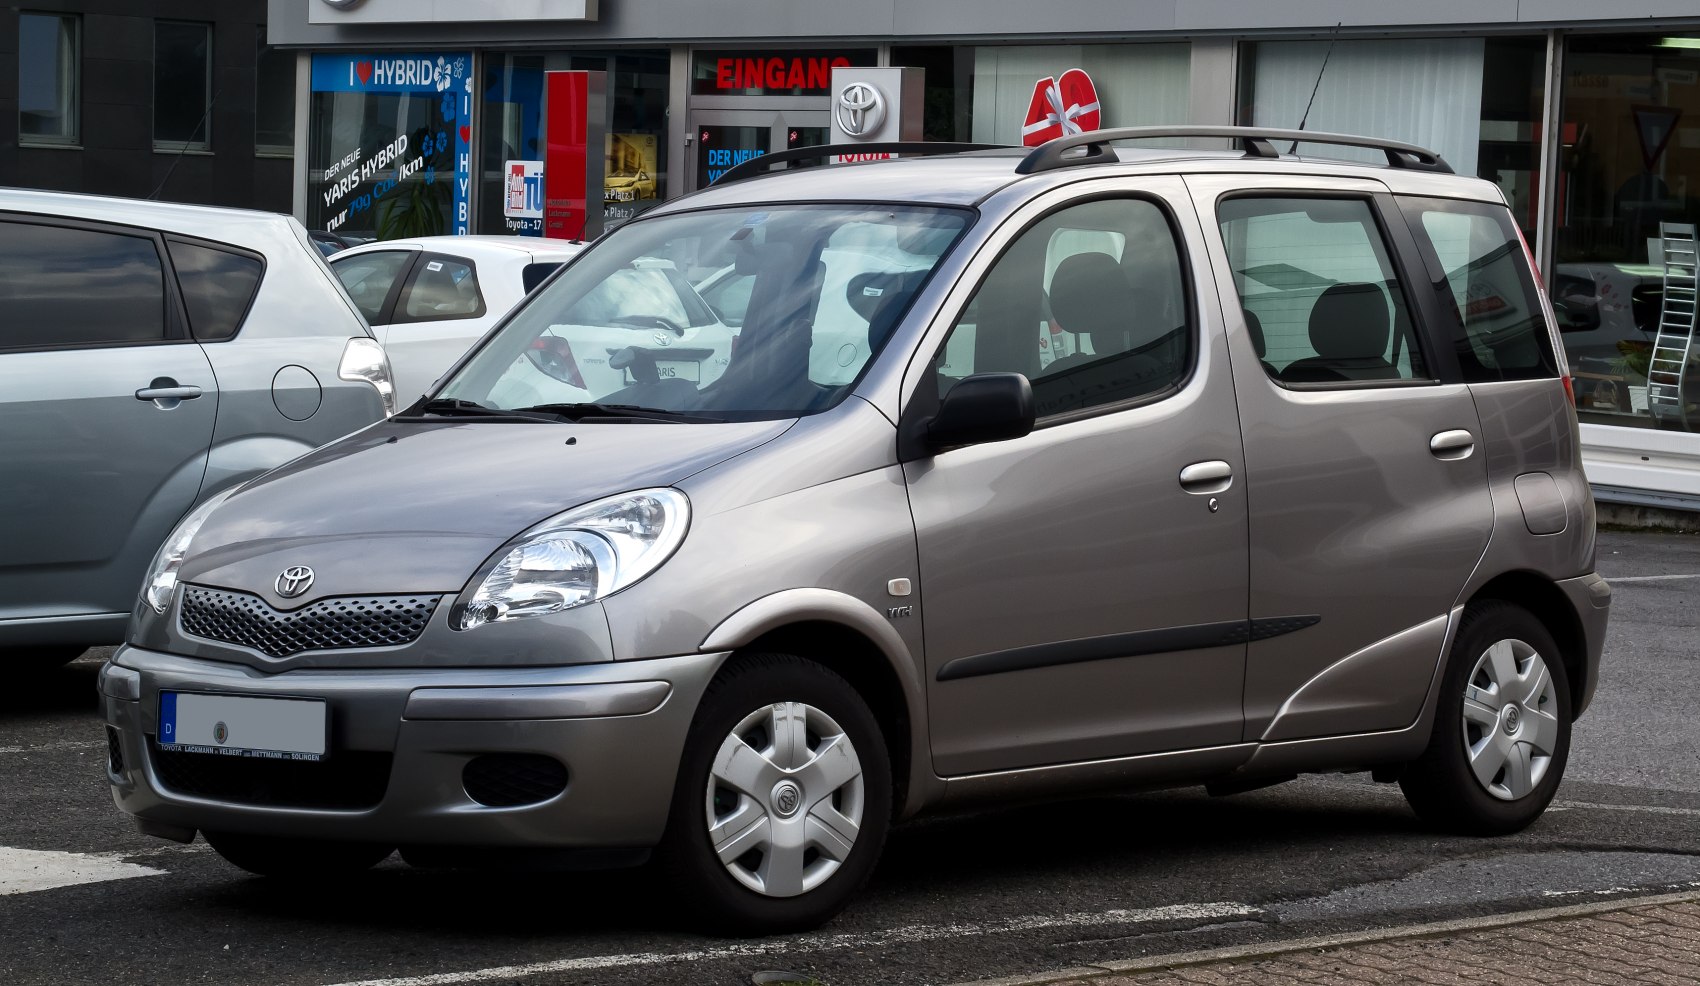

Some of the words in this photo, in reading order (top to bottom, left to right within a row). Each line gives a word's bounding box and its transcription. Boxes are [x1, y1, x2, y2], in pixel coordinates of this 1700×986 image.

[350, 61, 354, 87] I
[374, 60, 433, 85] HYBRID
[325, 162, 340, 181] DER
[341, 148, 361, 170] NEUE
[709, 149, 731, 166] DER
[324, 168, 360, 207] YARIS
[362, 134, 408, 181] HYBRID
[610, 188, 629, 200] Platz
[327, 208, 348, 233] nur
[610, 206, 629, 218] Platz
[506, 217, 528, 231] Toyota
[165, 723, 172, 734] D
[161, 744, 182, 752] TOYOTA
[185, 746, 213, 754] LACKMANN
[291, 753, 320, 761] SOLINGEN
